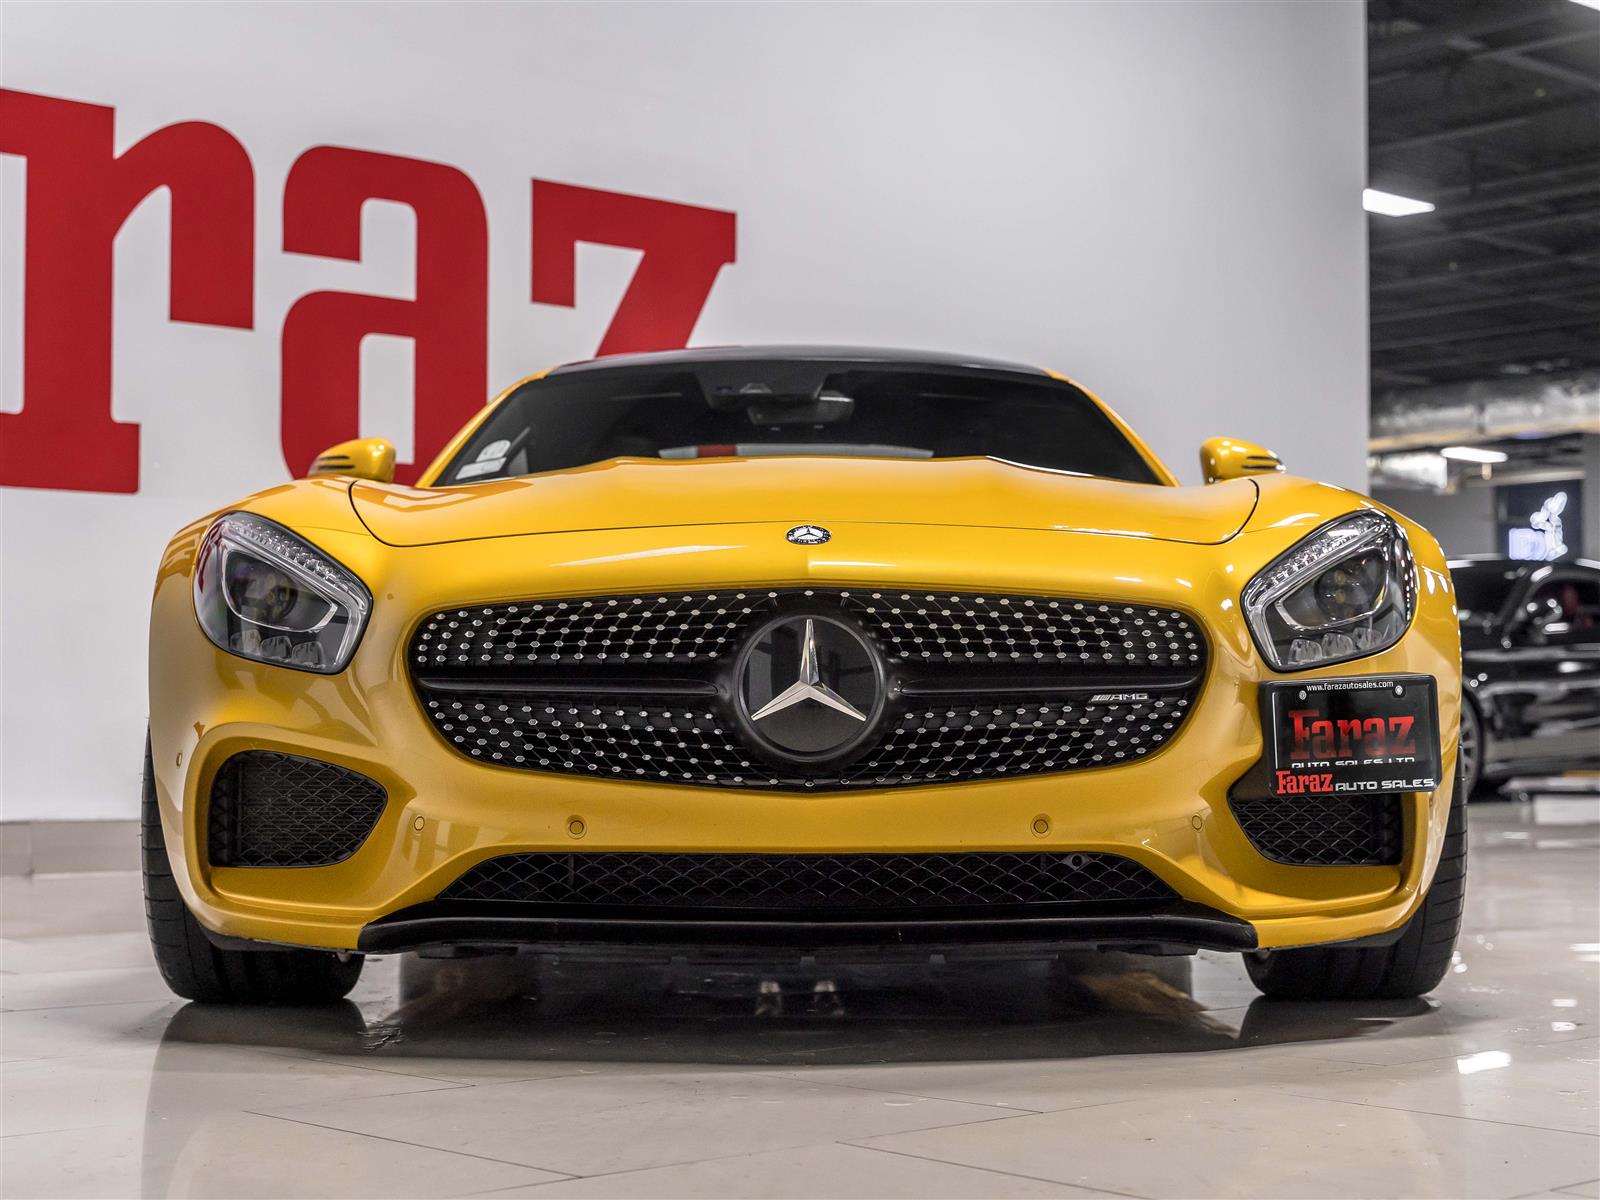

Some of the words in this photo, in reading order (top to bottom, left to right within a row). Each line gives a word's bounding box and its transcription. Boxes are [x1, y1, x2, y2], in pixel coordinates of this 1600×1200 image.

[1306, 680, 1394, 692] www.farazautosales.com
[1108, 693, 1148, 701] AMG
[1288, 709, 1416, 760] Faraz
[1275, 770, 1334, 795] Faraz
[1335, 780, 1378, 791] AUTO
[1381, 778, 1435, 789] SALES
